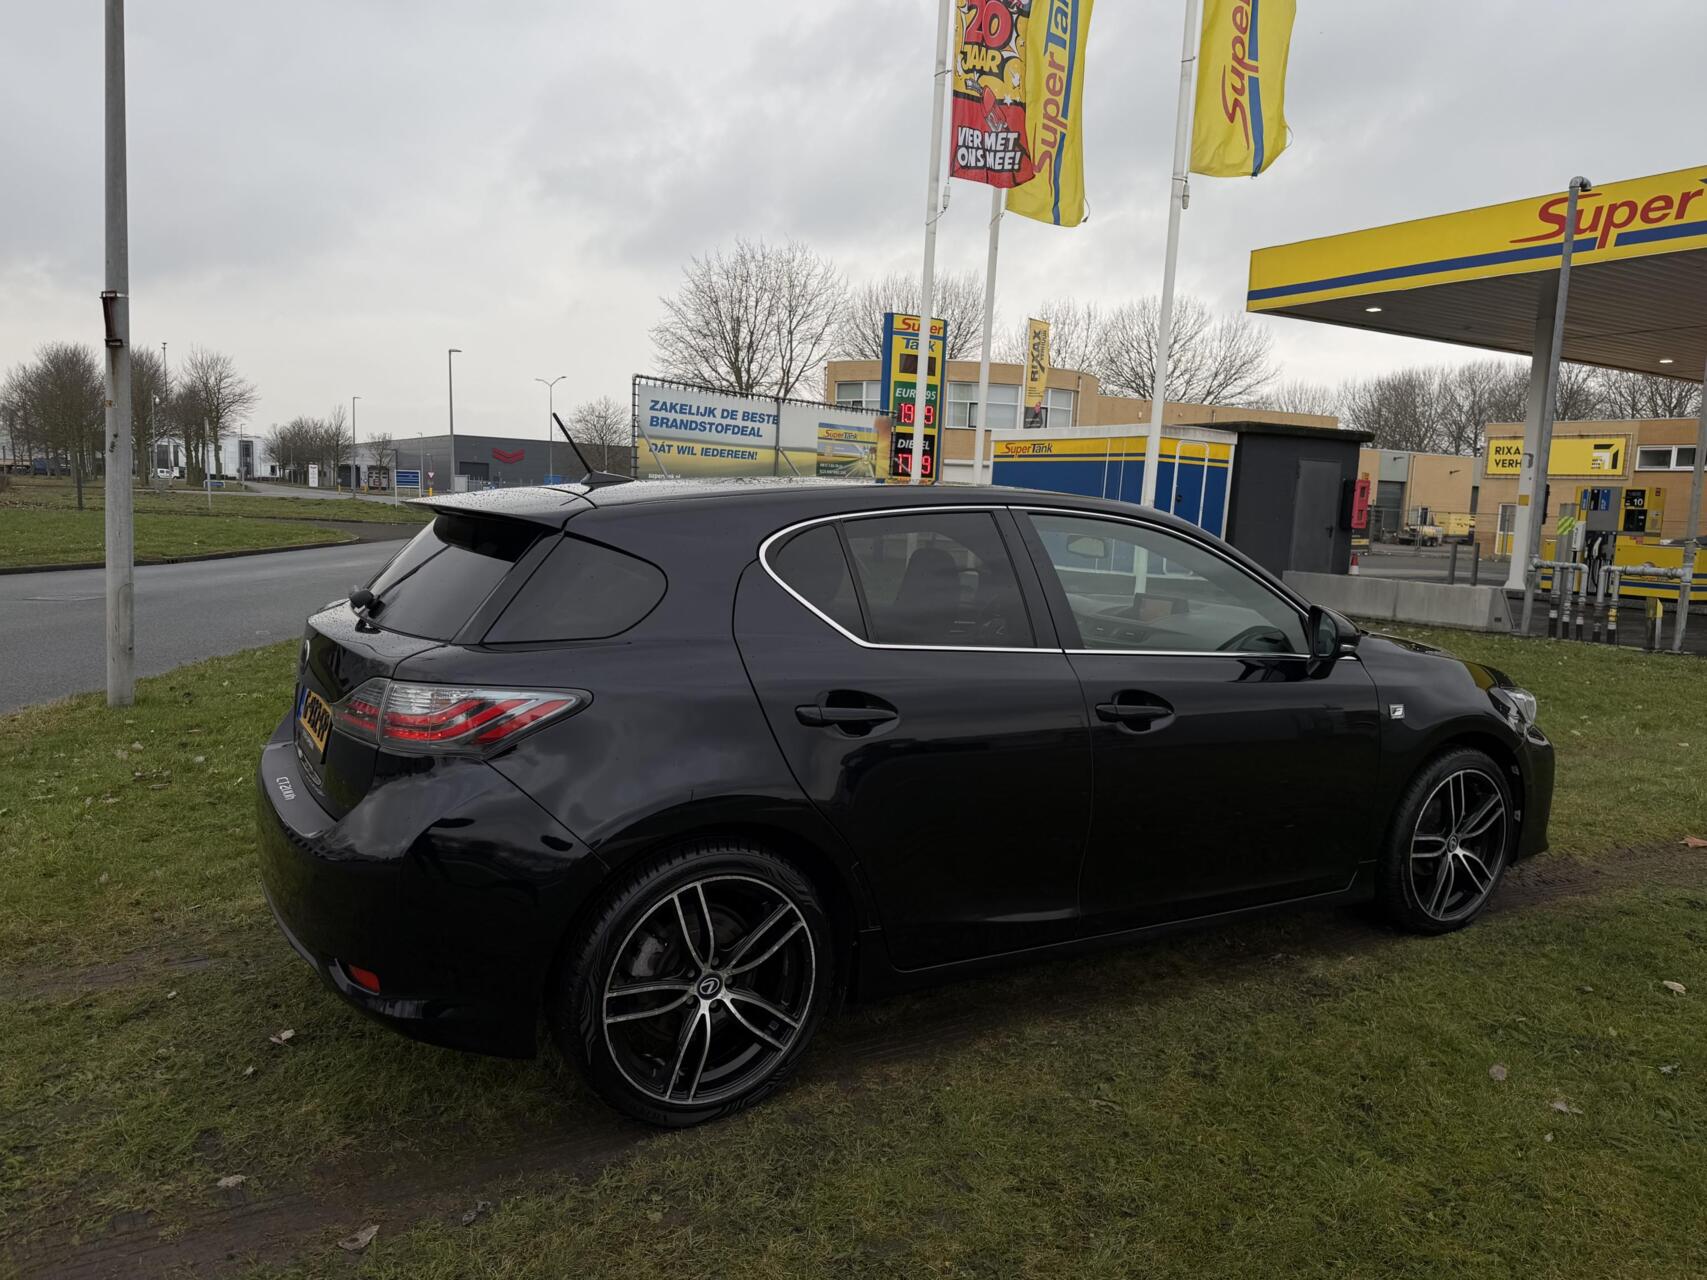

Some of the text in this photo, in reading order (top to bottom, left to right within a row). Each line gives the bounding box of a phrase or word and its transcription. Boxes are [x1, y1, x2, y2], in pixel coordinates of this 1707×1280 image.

[965, 0, 1013, 48] 20
[962, 44, 1001, 73] JAAR
[1033, 0, 1070, 197] SuperTa
[957, 127, 1018, 150] VIER MET
[957, 147, 1021, 171] ONS MEE!
[1509, 184, 1707, 249] Super
[894, 317, 944, 335] Suer
[901, 336, 936, 353] Tak
[649, 399, 779, 425] ZAKELIJK DE BESTE
[649, 415, 763, 438] BRANDSTOFDEAL
[676, 445, 697, 456] WIL
[700, 447, 758, 460] IEDEREEN!
[897, 439, 931, 450] DIEEL
[1002, 441, 1053, 458] SuperTank
[1494, 446, 1521, 456] RIXA
[1494, 458, 1522, 468] VERH
[1633, 498, 1644, 506] 10
